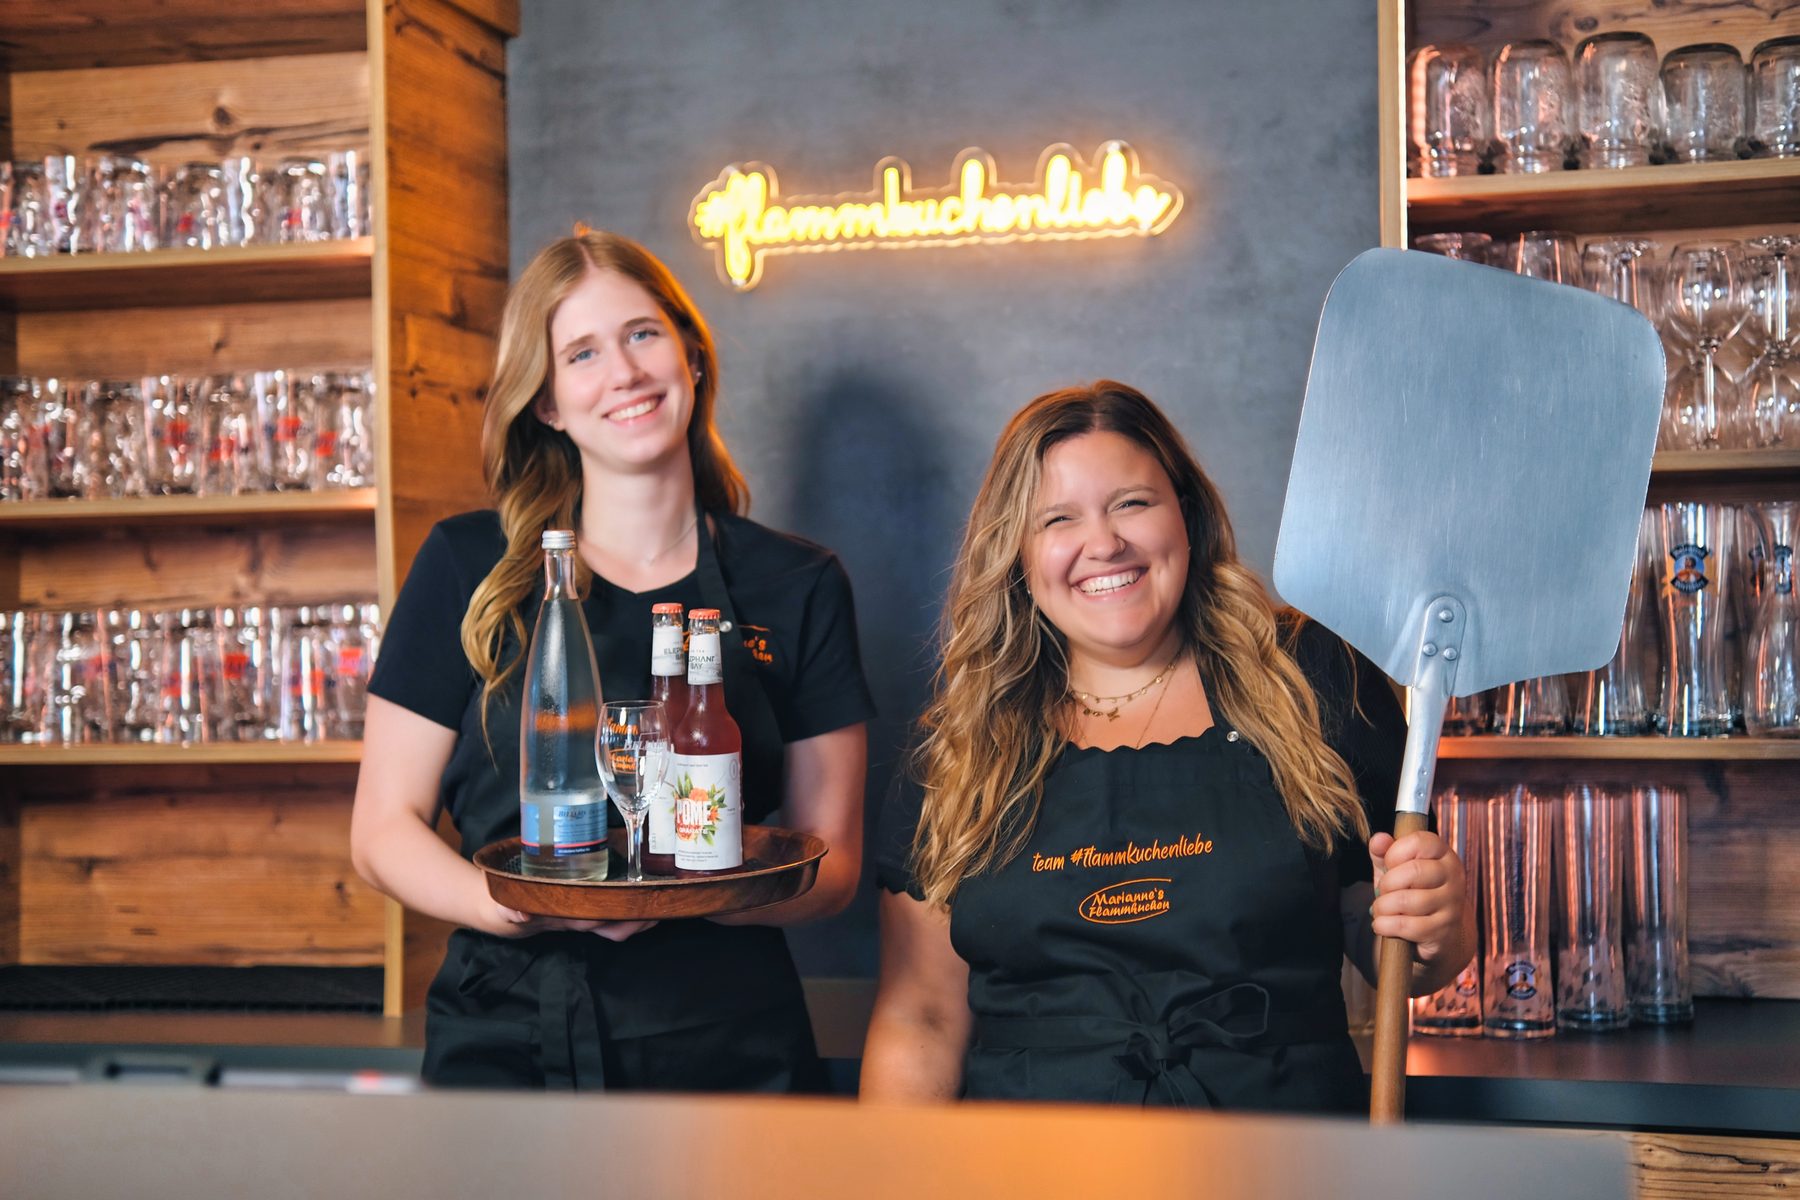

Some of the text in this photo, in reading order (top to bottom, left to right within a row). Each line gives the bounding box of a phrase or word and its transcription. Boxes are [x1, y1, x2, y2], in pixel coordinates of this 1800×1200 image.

[676, 798, 713, 826] POME
[1032, 852, 1065, 872] team
[1091, 887, 1165, 907] Marianne's
[1088, 900, 1171, 918] Flammkuchen
